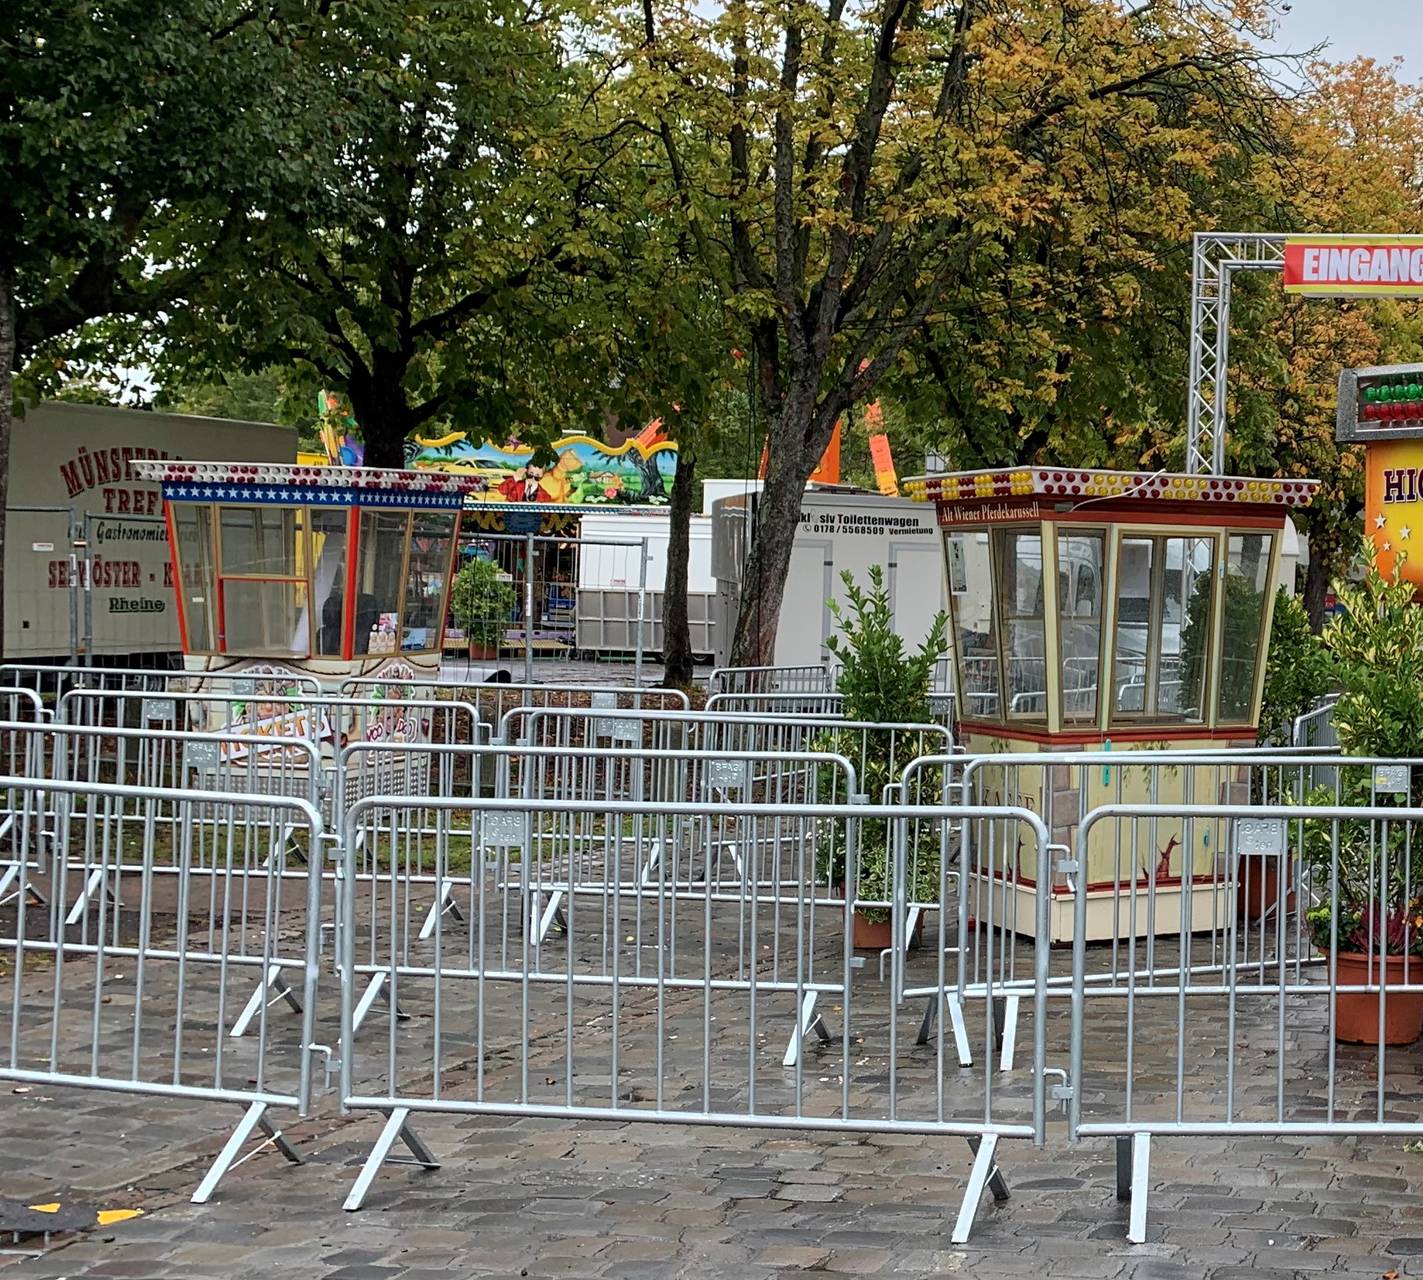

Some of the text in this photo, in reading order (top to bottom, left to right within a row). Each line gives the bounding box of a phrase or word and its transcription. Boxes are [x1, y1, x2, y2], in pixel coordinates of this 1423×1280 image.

[942, 501, 1040, 522] Alt Wiener Pferdekarussell
[837, 513, 919, 528] Toilettenwagen
[813, 524, 835, 534] 0178
[889, 527, 934, 535] Vermietung
[109, 597, 165, 612] Rheine
